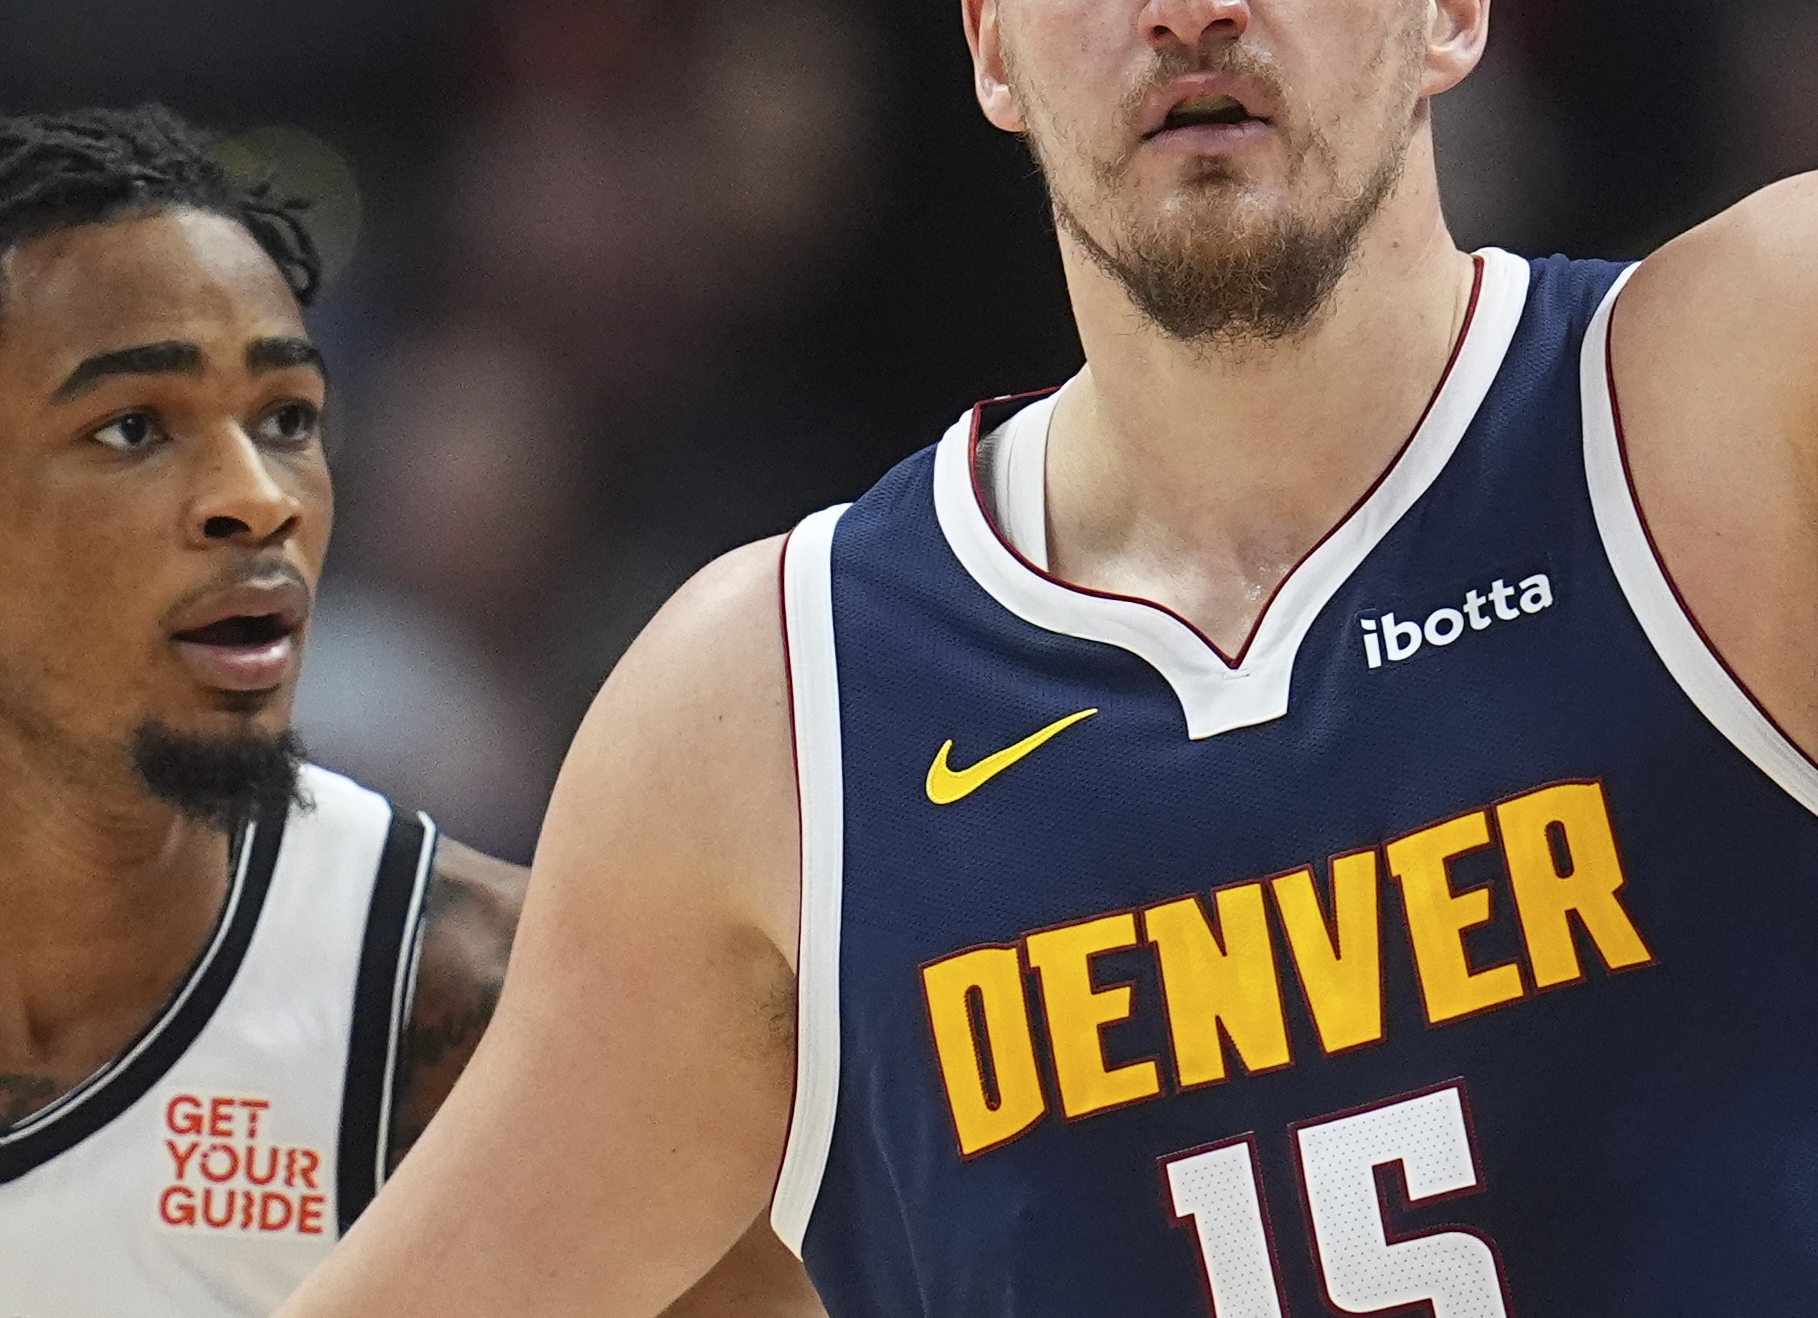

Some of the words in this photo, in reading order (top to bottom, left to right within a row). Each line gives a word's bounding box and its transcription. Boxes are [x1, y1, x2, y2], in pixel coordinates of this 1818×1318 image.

[1359, 573, 1554, 669] ibotta
[919, 778, 1658, 1160] DENVER
[165, 1093, 271, 1139] GET
[164, 1139, 321, 1189] YOUR
[159, 1184, 326, 1235] GUIDE
